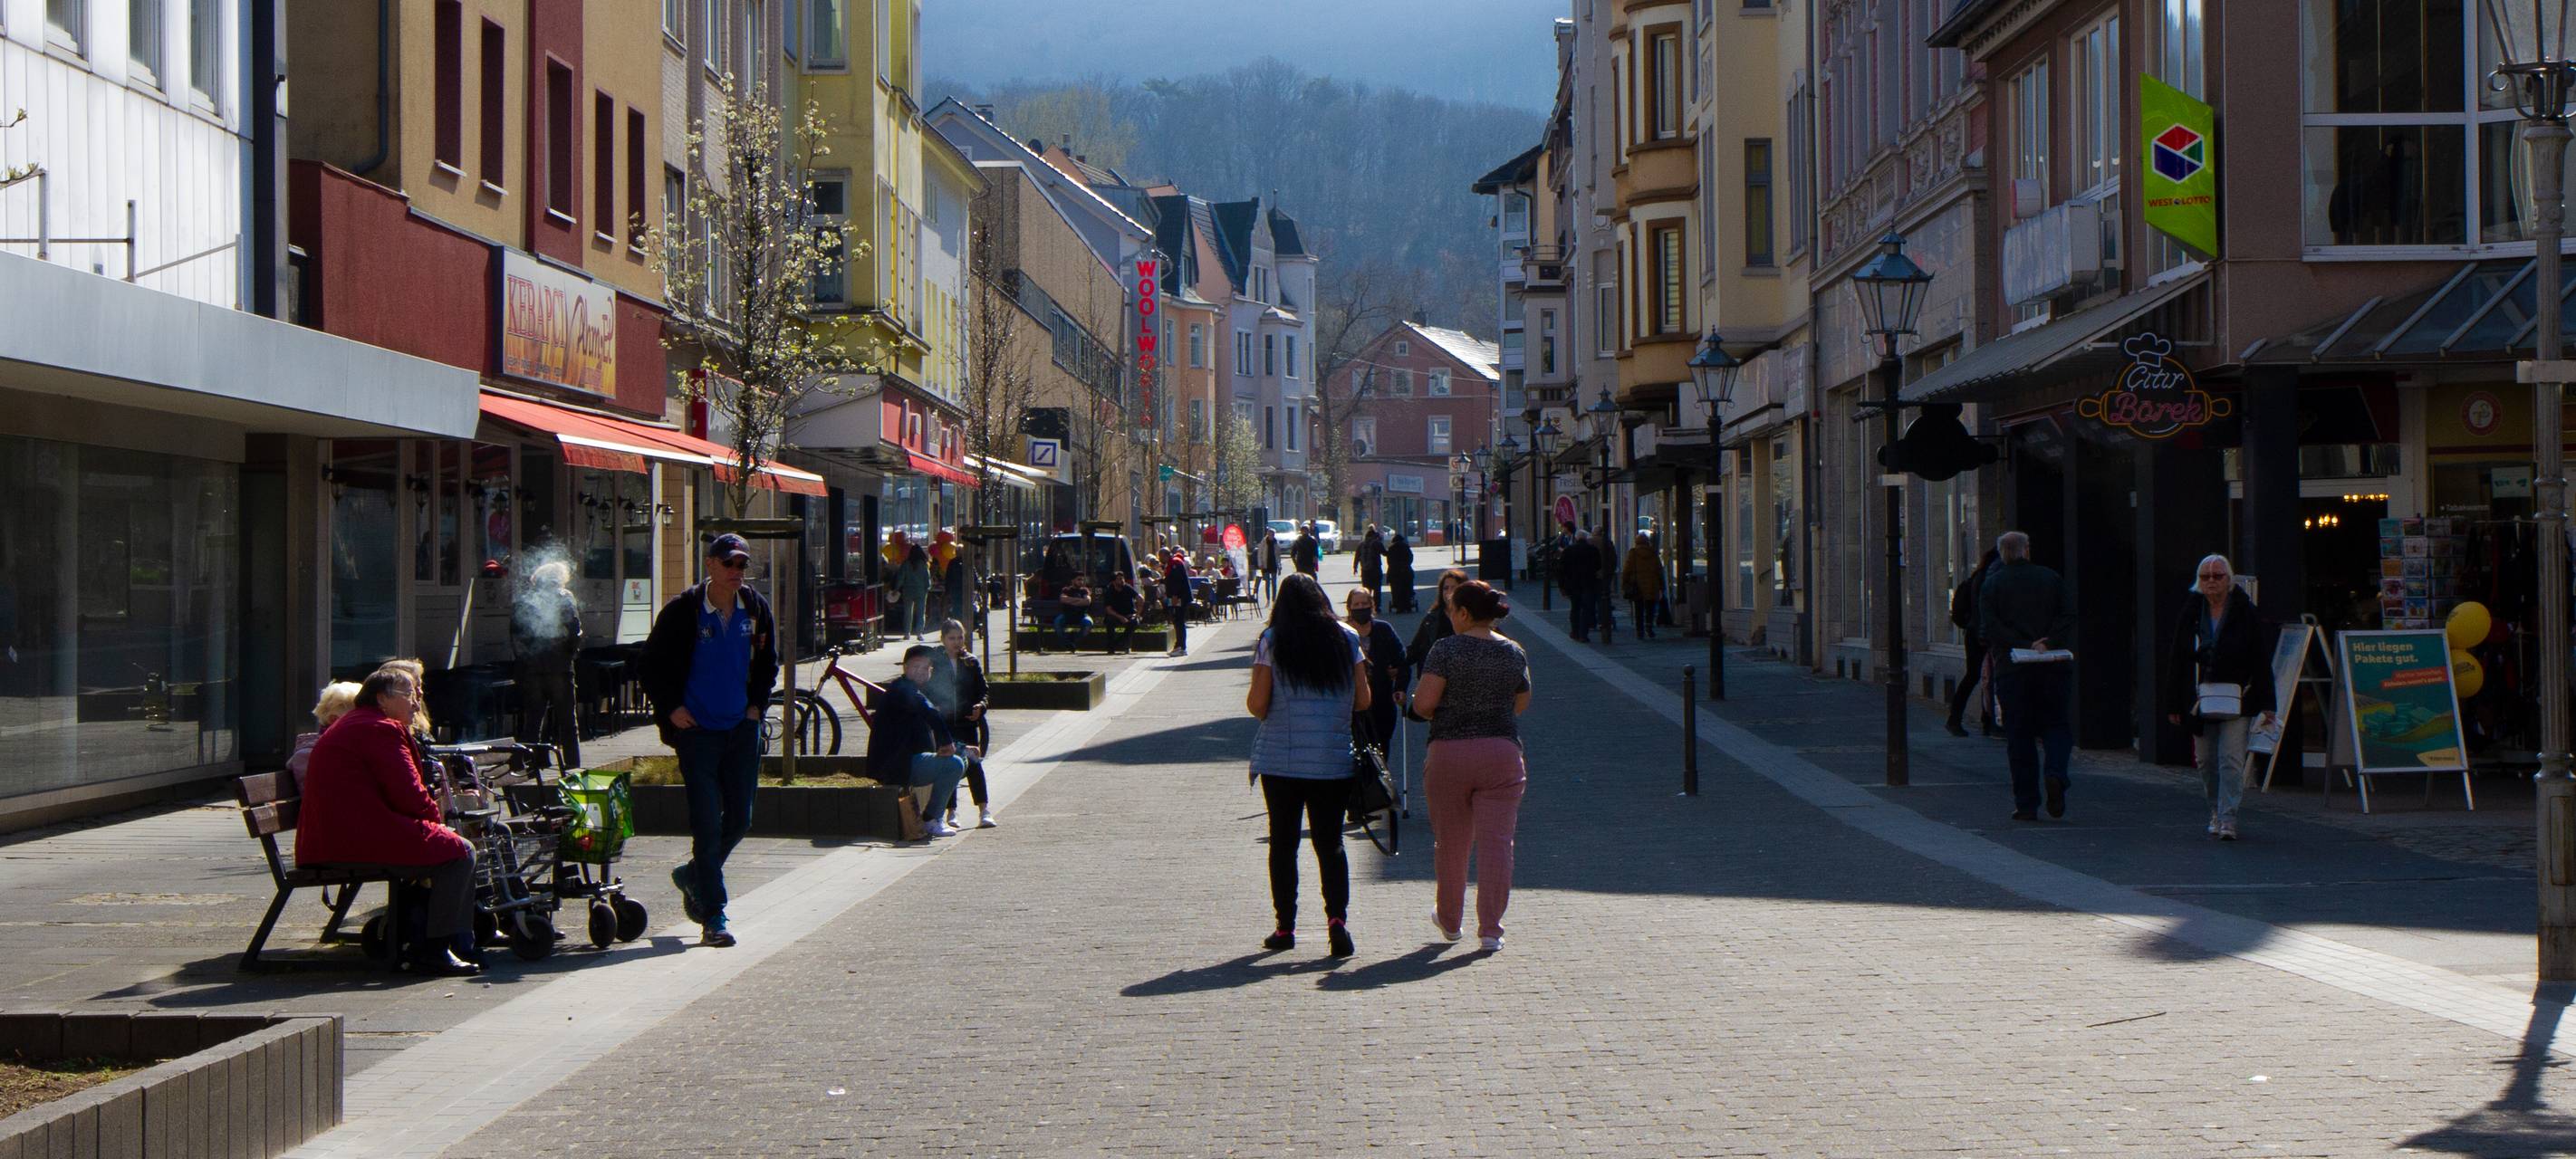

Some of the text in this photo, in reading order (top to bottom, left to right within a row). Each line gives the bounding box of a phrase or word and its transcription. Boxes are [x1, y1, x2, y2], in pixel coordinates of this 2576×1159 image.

[2148, 195, 2211, 207] WEST LOTTO
[1559, 477, 1583, 487] FRISEU
[2352, 641, 2414, 653] Hier liegen
[2355, 654, 2419, 666] Pakete gut.
